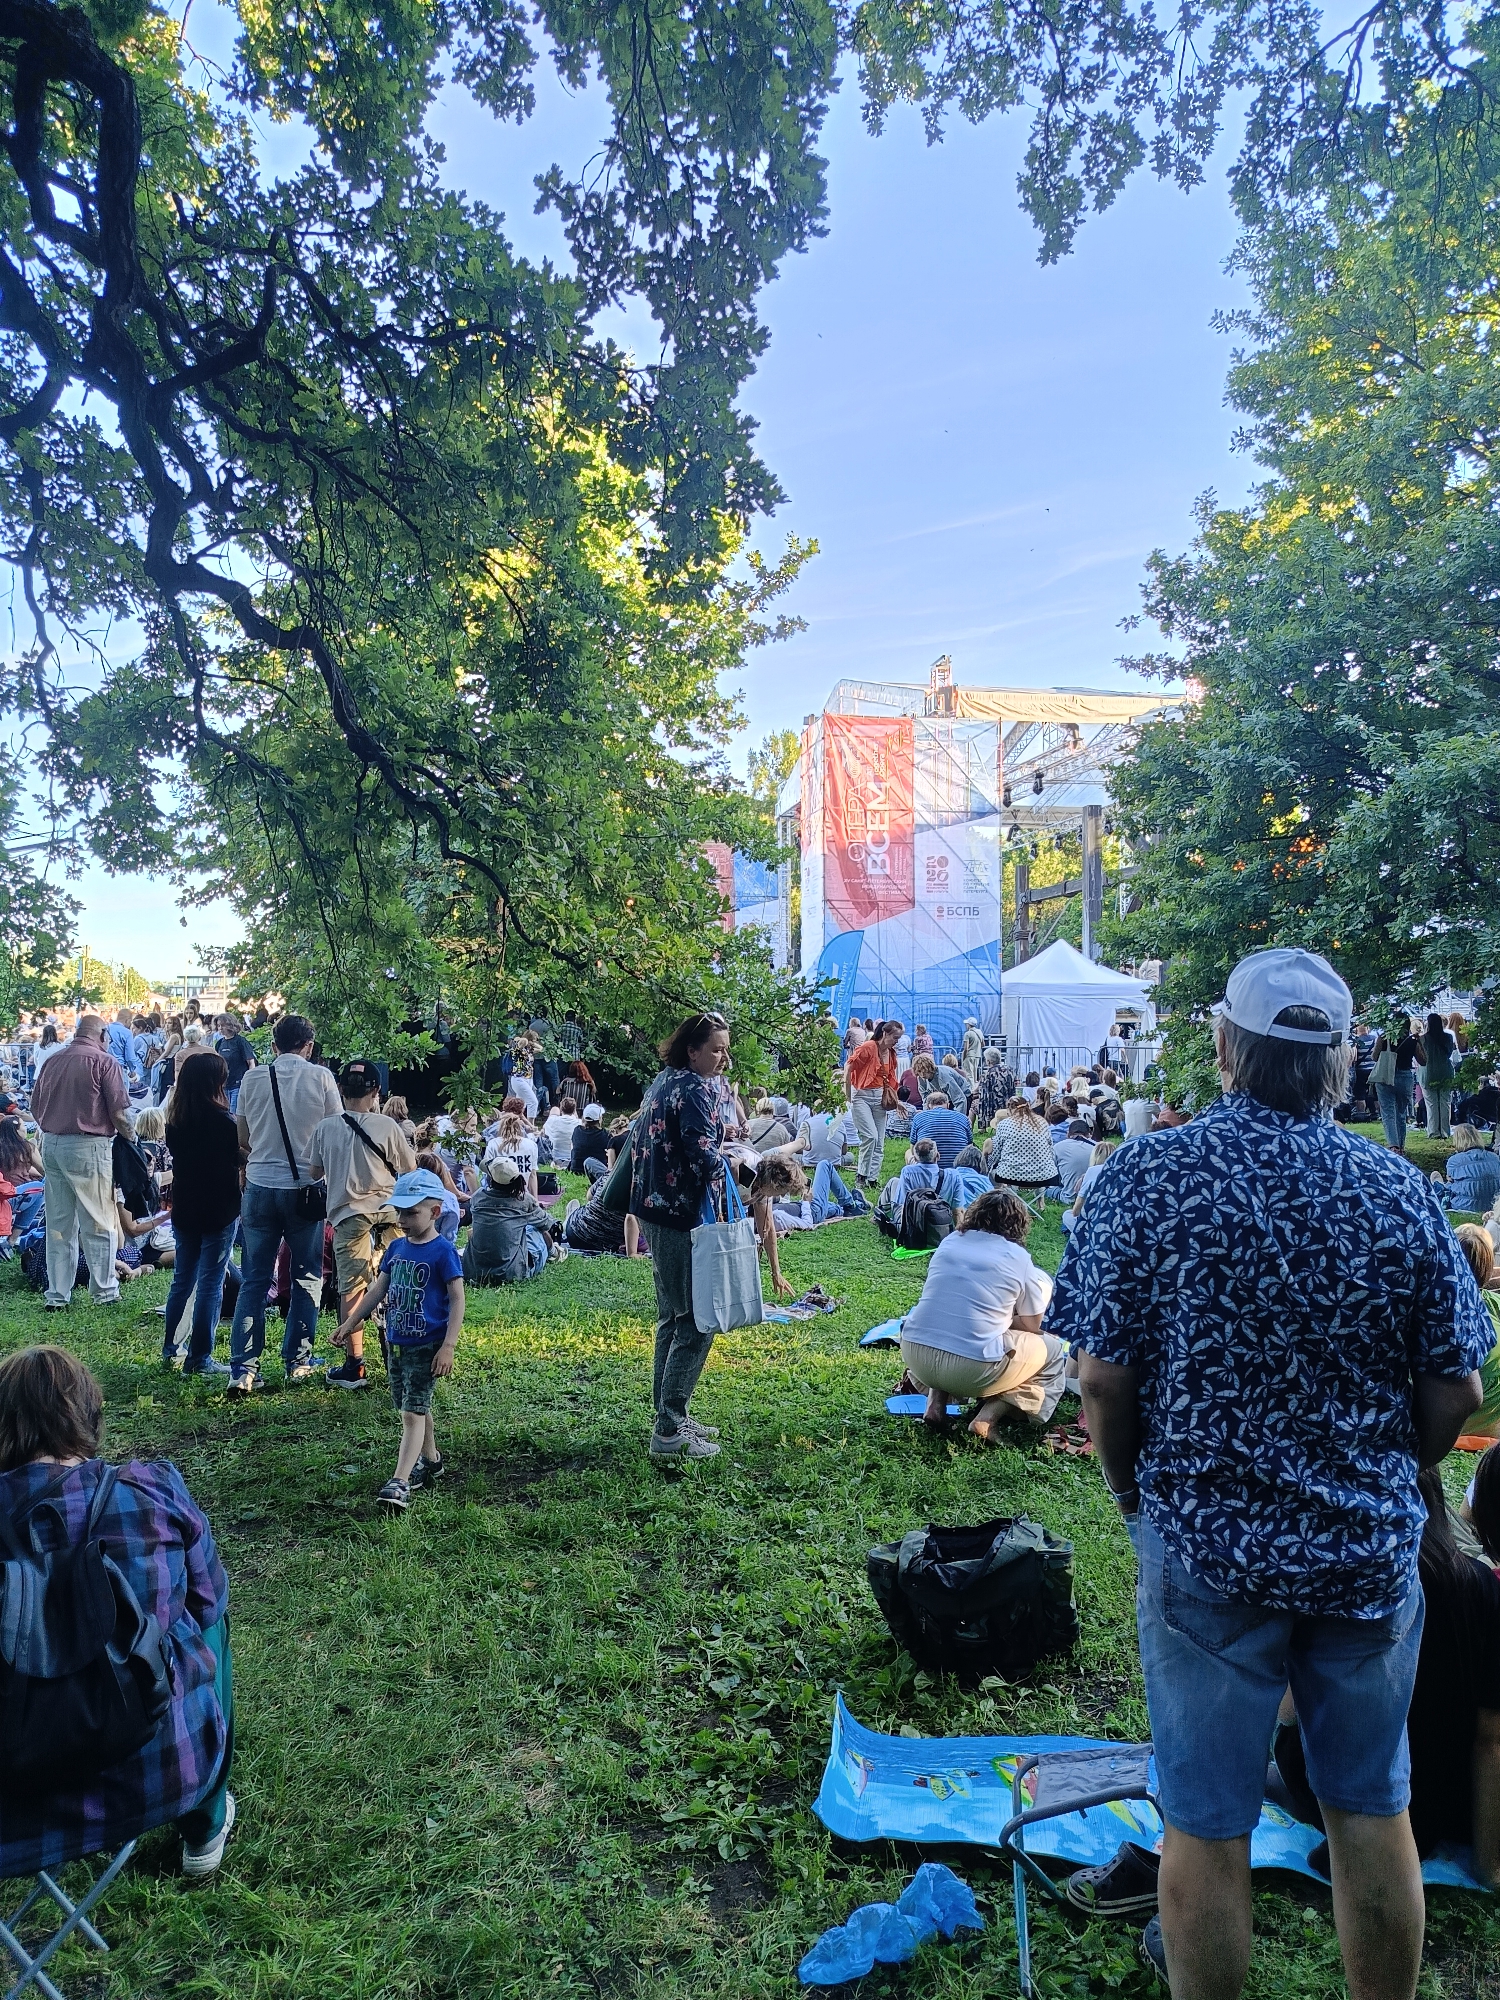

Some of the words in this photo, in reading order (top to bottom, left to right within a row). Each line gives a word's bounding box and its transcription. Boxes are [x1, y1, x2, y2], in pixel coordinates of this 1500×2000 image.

[848, 780, 865, 861] ОПЕРА
[866, 782, 890, 875] ВСЕМ
[946, 906, 980, 916] БСПБ
